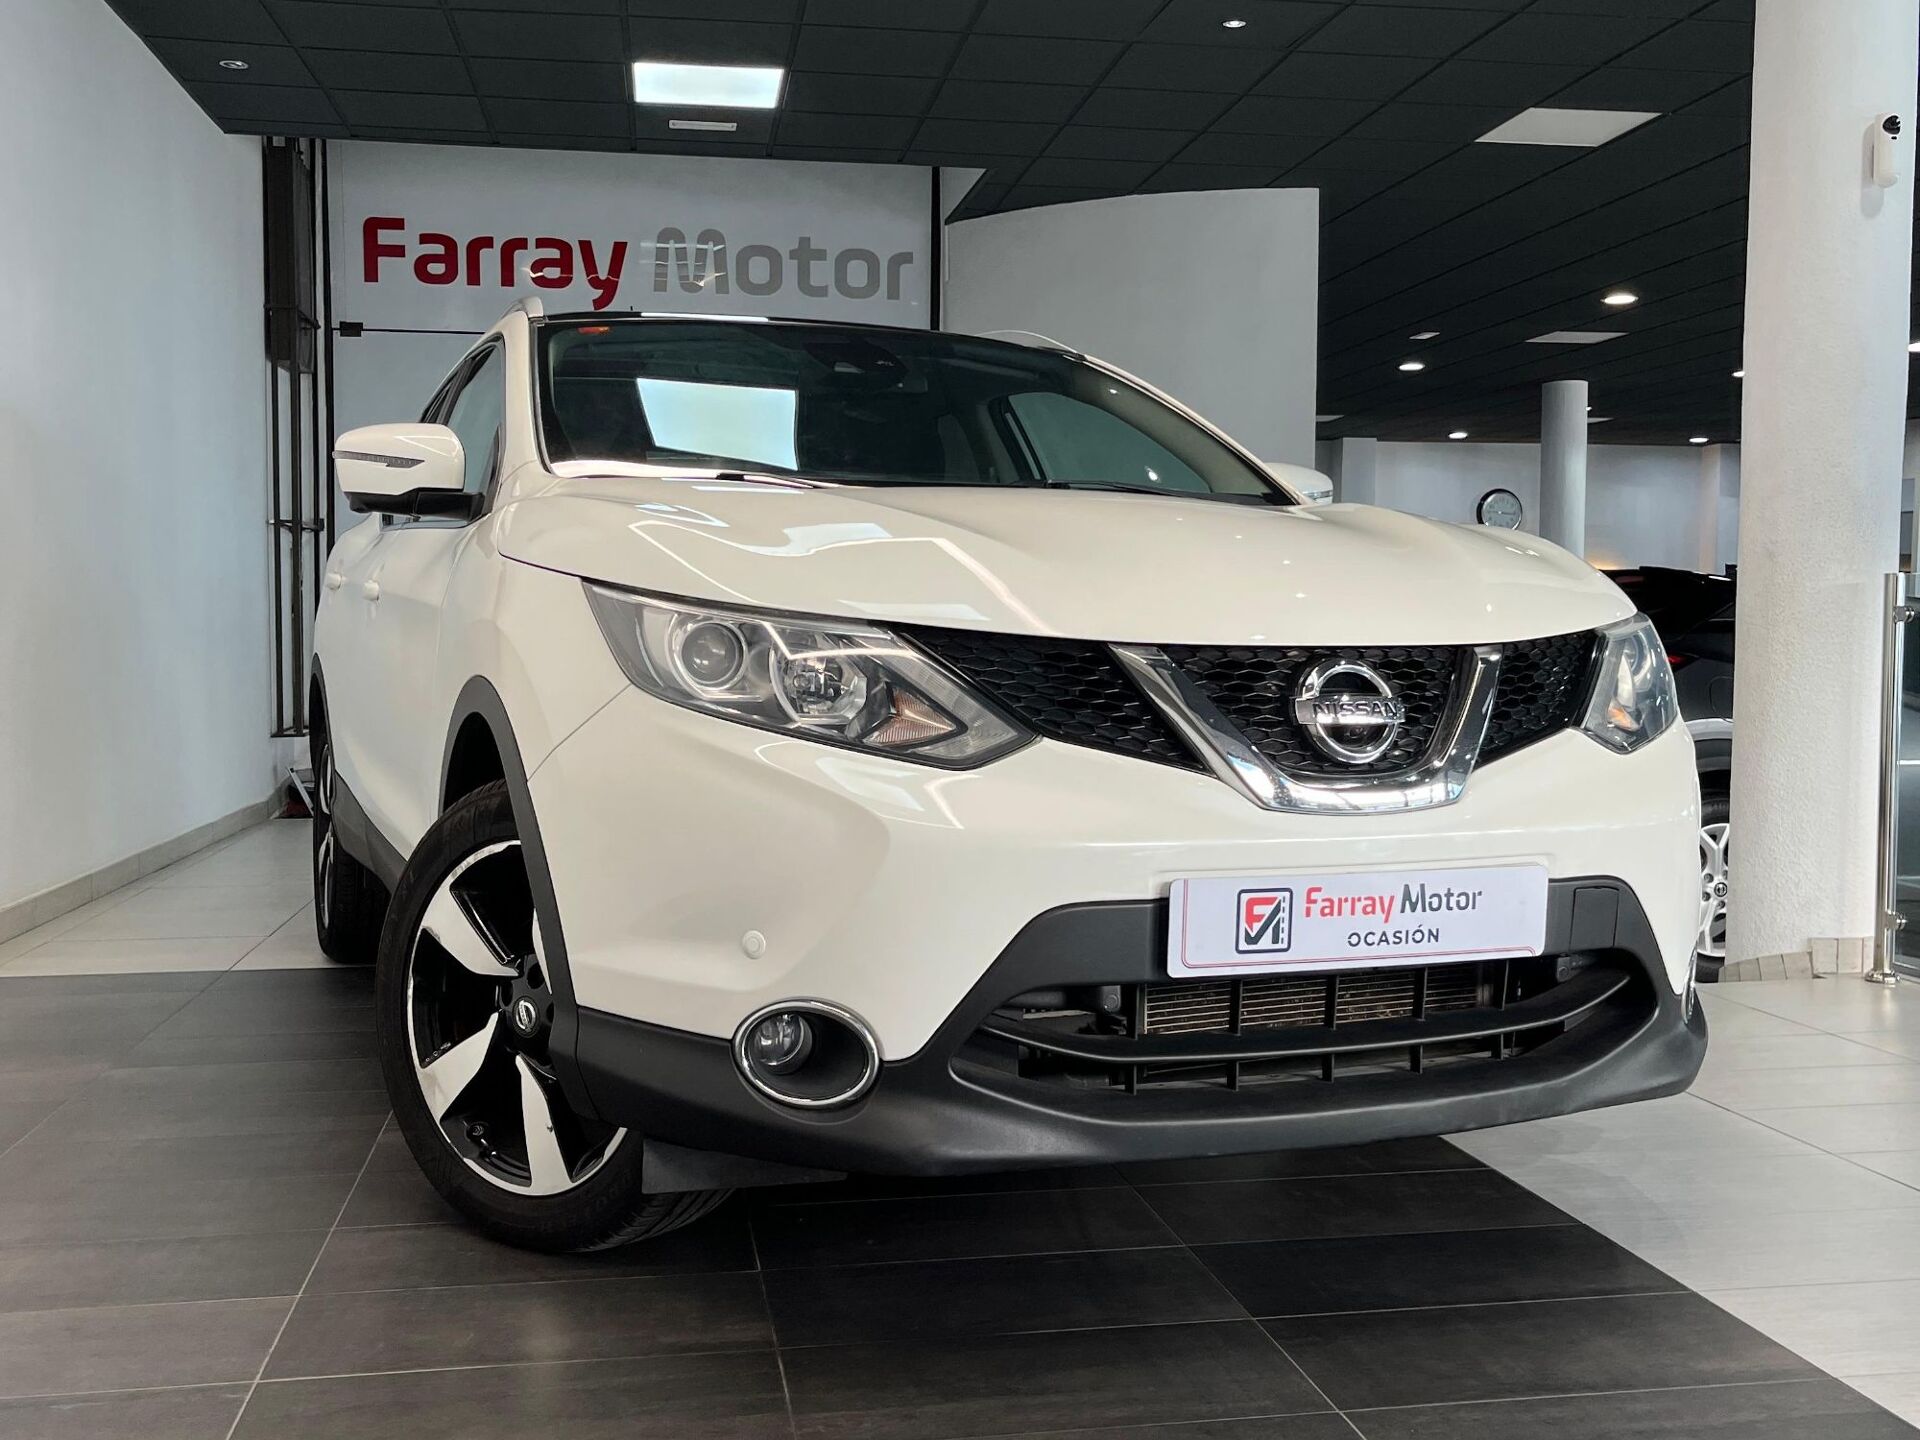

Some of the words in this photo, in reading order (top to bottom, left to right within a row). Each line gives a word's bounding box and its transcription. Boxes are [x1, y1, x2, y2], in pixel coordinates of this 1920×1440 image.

[363, 216, 628, 310] Farray
[652, 227, 914, 300] Motor
[1312, 701, 1399, 717] NISSAN
[1304, 886, 1395, 923] Farray
[1400, 883, 1482, 913] Motor
[1347, 924, 1440, 947] OCASIÓN
